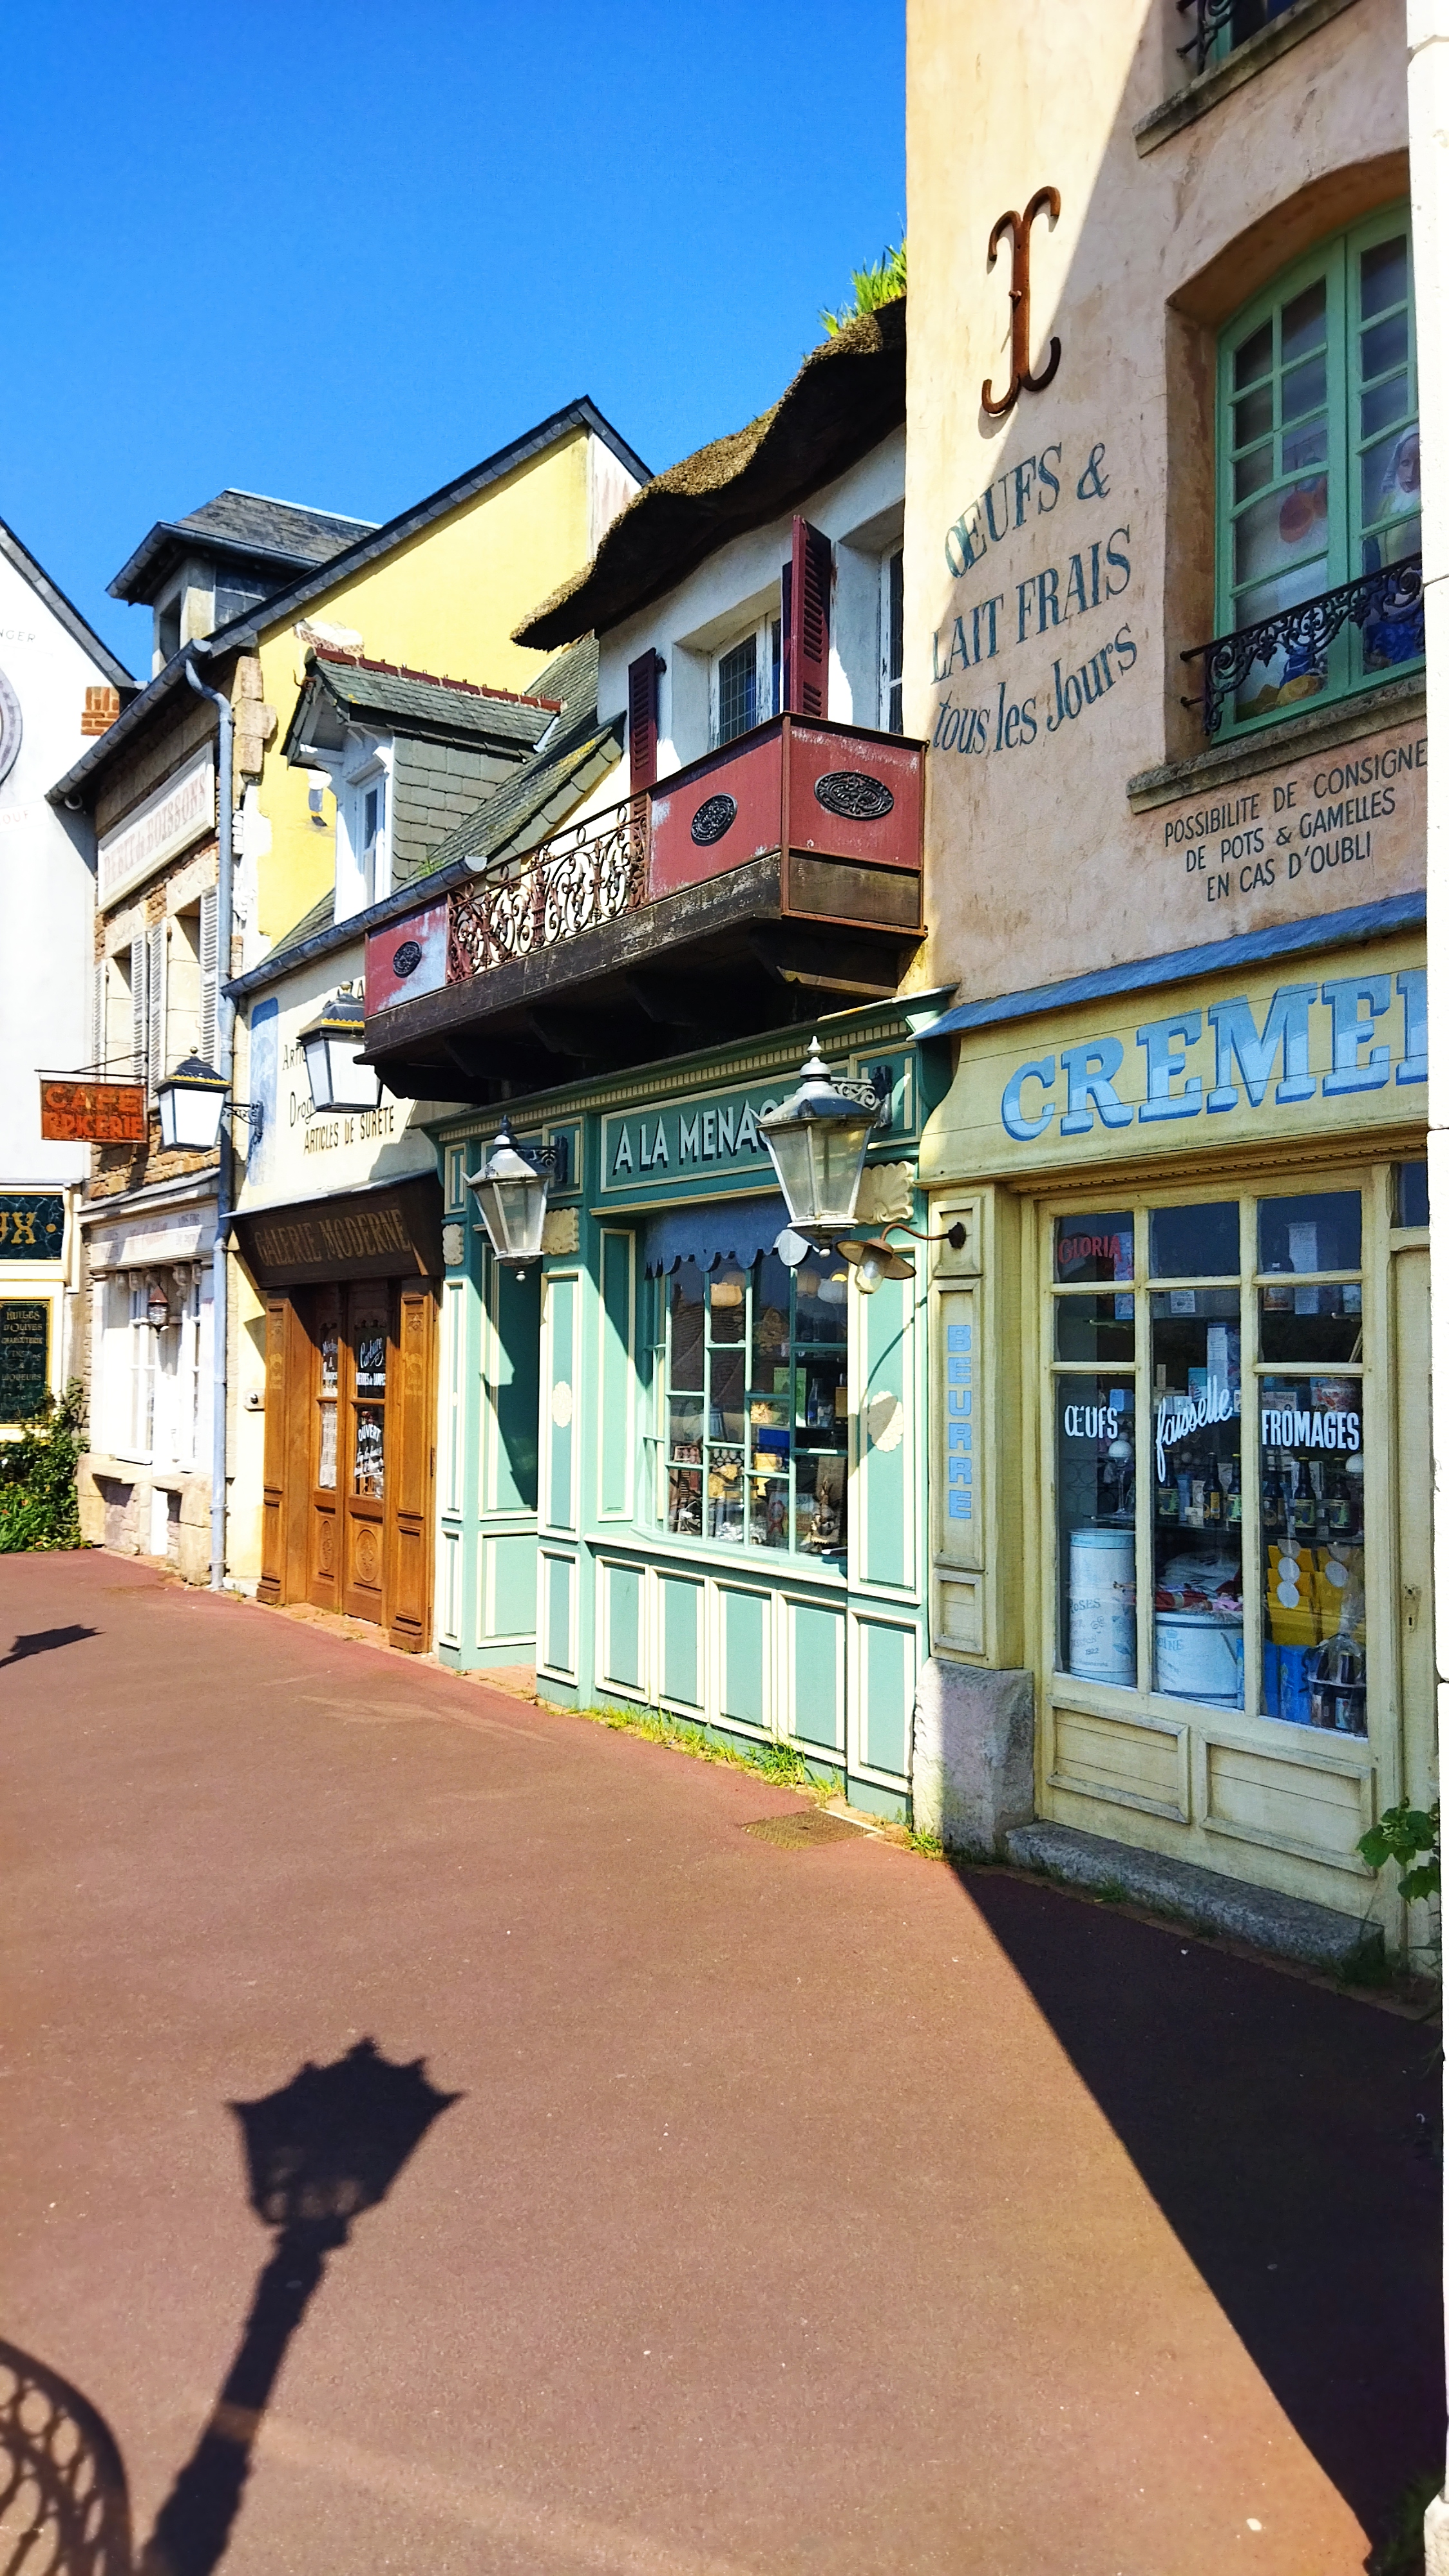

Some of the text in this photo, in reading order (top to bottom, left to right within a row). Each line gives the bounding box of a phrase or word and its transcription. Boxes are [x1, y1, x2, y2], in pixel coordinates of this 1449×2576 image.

[945, 442, 1112, 579] ŒUFS &
[931, 524, 1131, 685] LAIT FRAIS
[933, 622, 1138, 755] tous les Jours
[1164, 739, 1428, 848] POSSIBILITE DE CONSIGNE
[1186, 786, 1396, 873] DE POTS & GAMELLES
[1207, 831, 1371, 902] EN CAS D'OUBLI
[46, 1086, 142, 1113] CAFE
[303, 1122, 339, 1157] ARTICLES
[360, 1105, 394, 1141] SURETE
[613, 1122, 633, 1175] A
[639, 1115, 669, 1171] LA
[254, 1209, 412, 1267] GALERIE MODERNE
[1058, 1235, 1122, 1264] GLORIA
[947, 1325, 972, 1519] BEURRE
[1156, 1374, 1233, 1482] faisselle
[1261, 1409, 1359, 1450] FROMAGES
